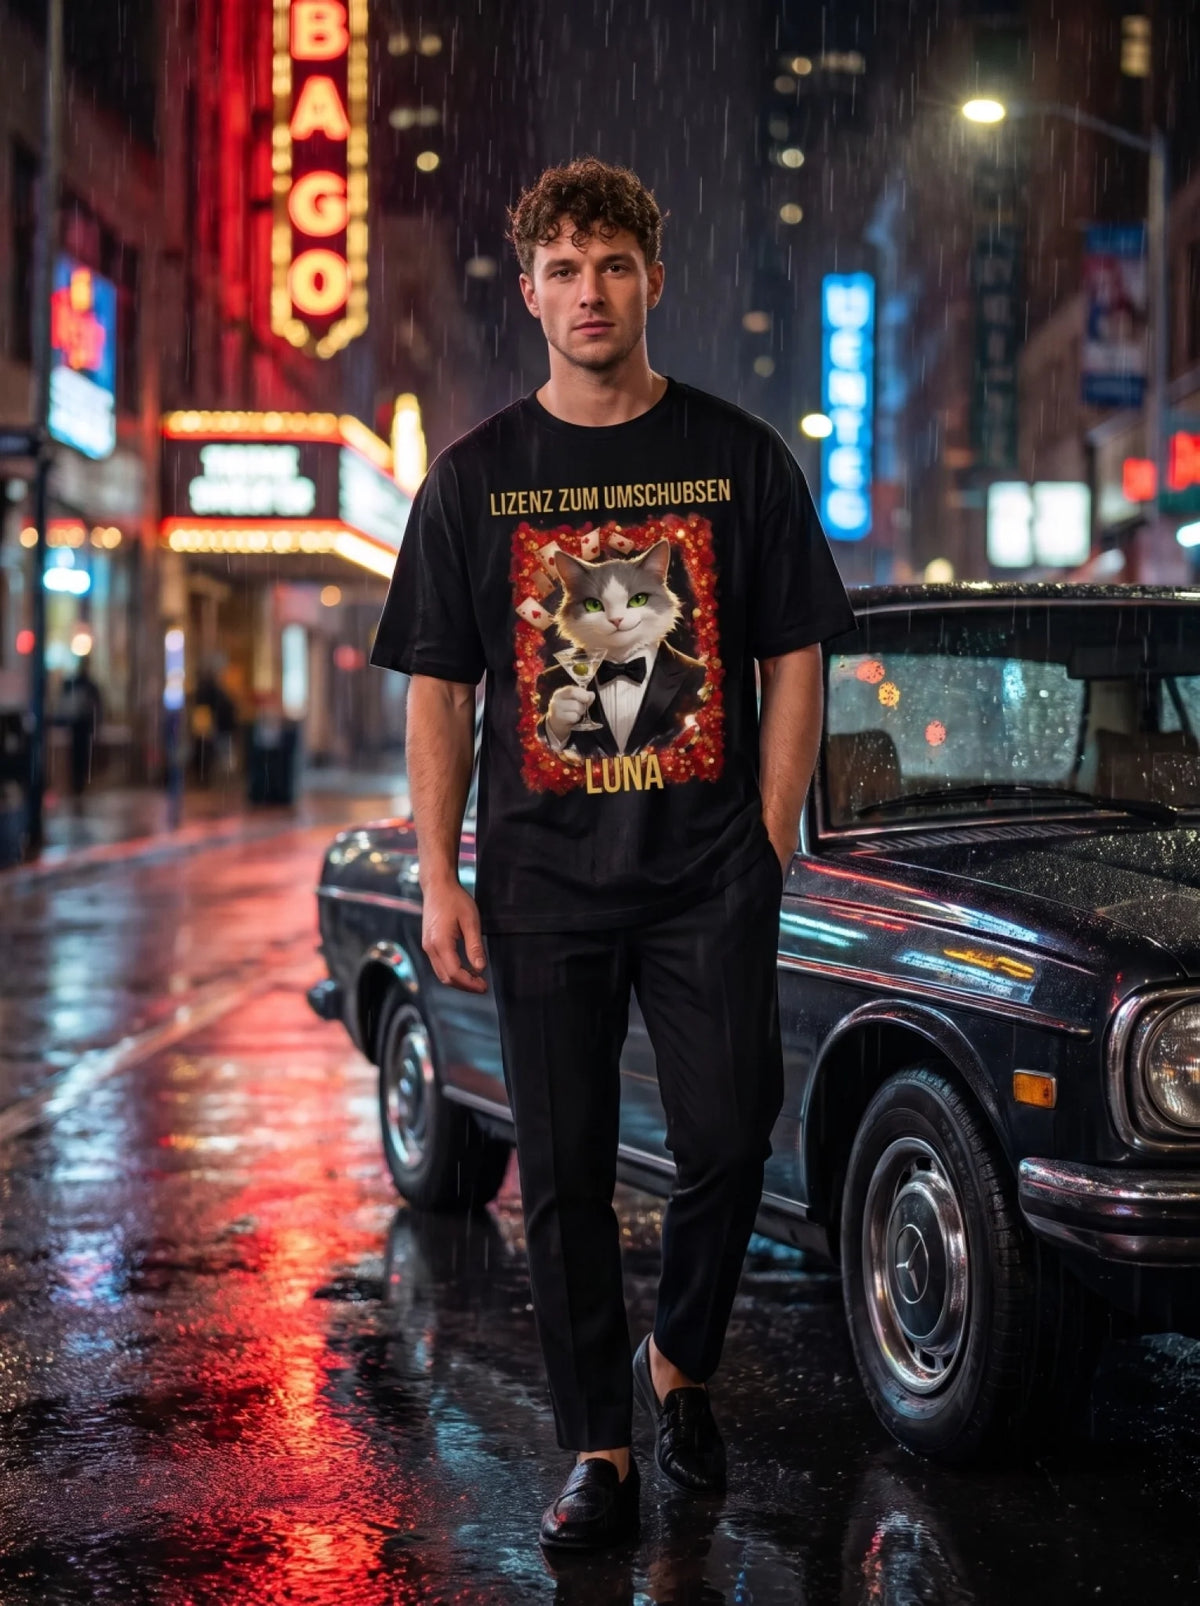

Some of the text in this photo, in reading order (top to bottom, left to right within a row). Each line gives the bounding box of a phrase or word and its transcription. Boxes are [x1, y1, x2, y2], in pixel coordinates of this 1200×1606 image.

[288, 0, 350, 316] BAGO
[490, 478, 731, 515] LIZENZ ZUM UMSCHUBSEN
[585, 754, 664, 794] LUNA
